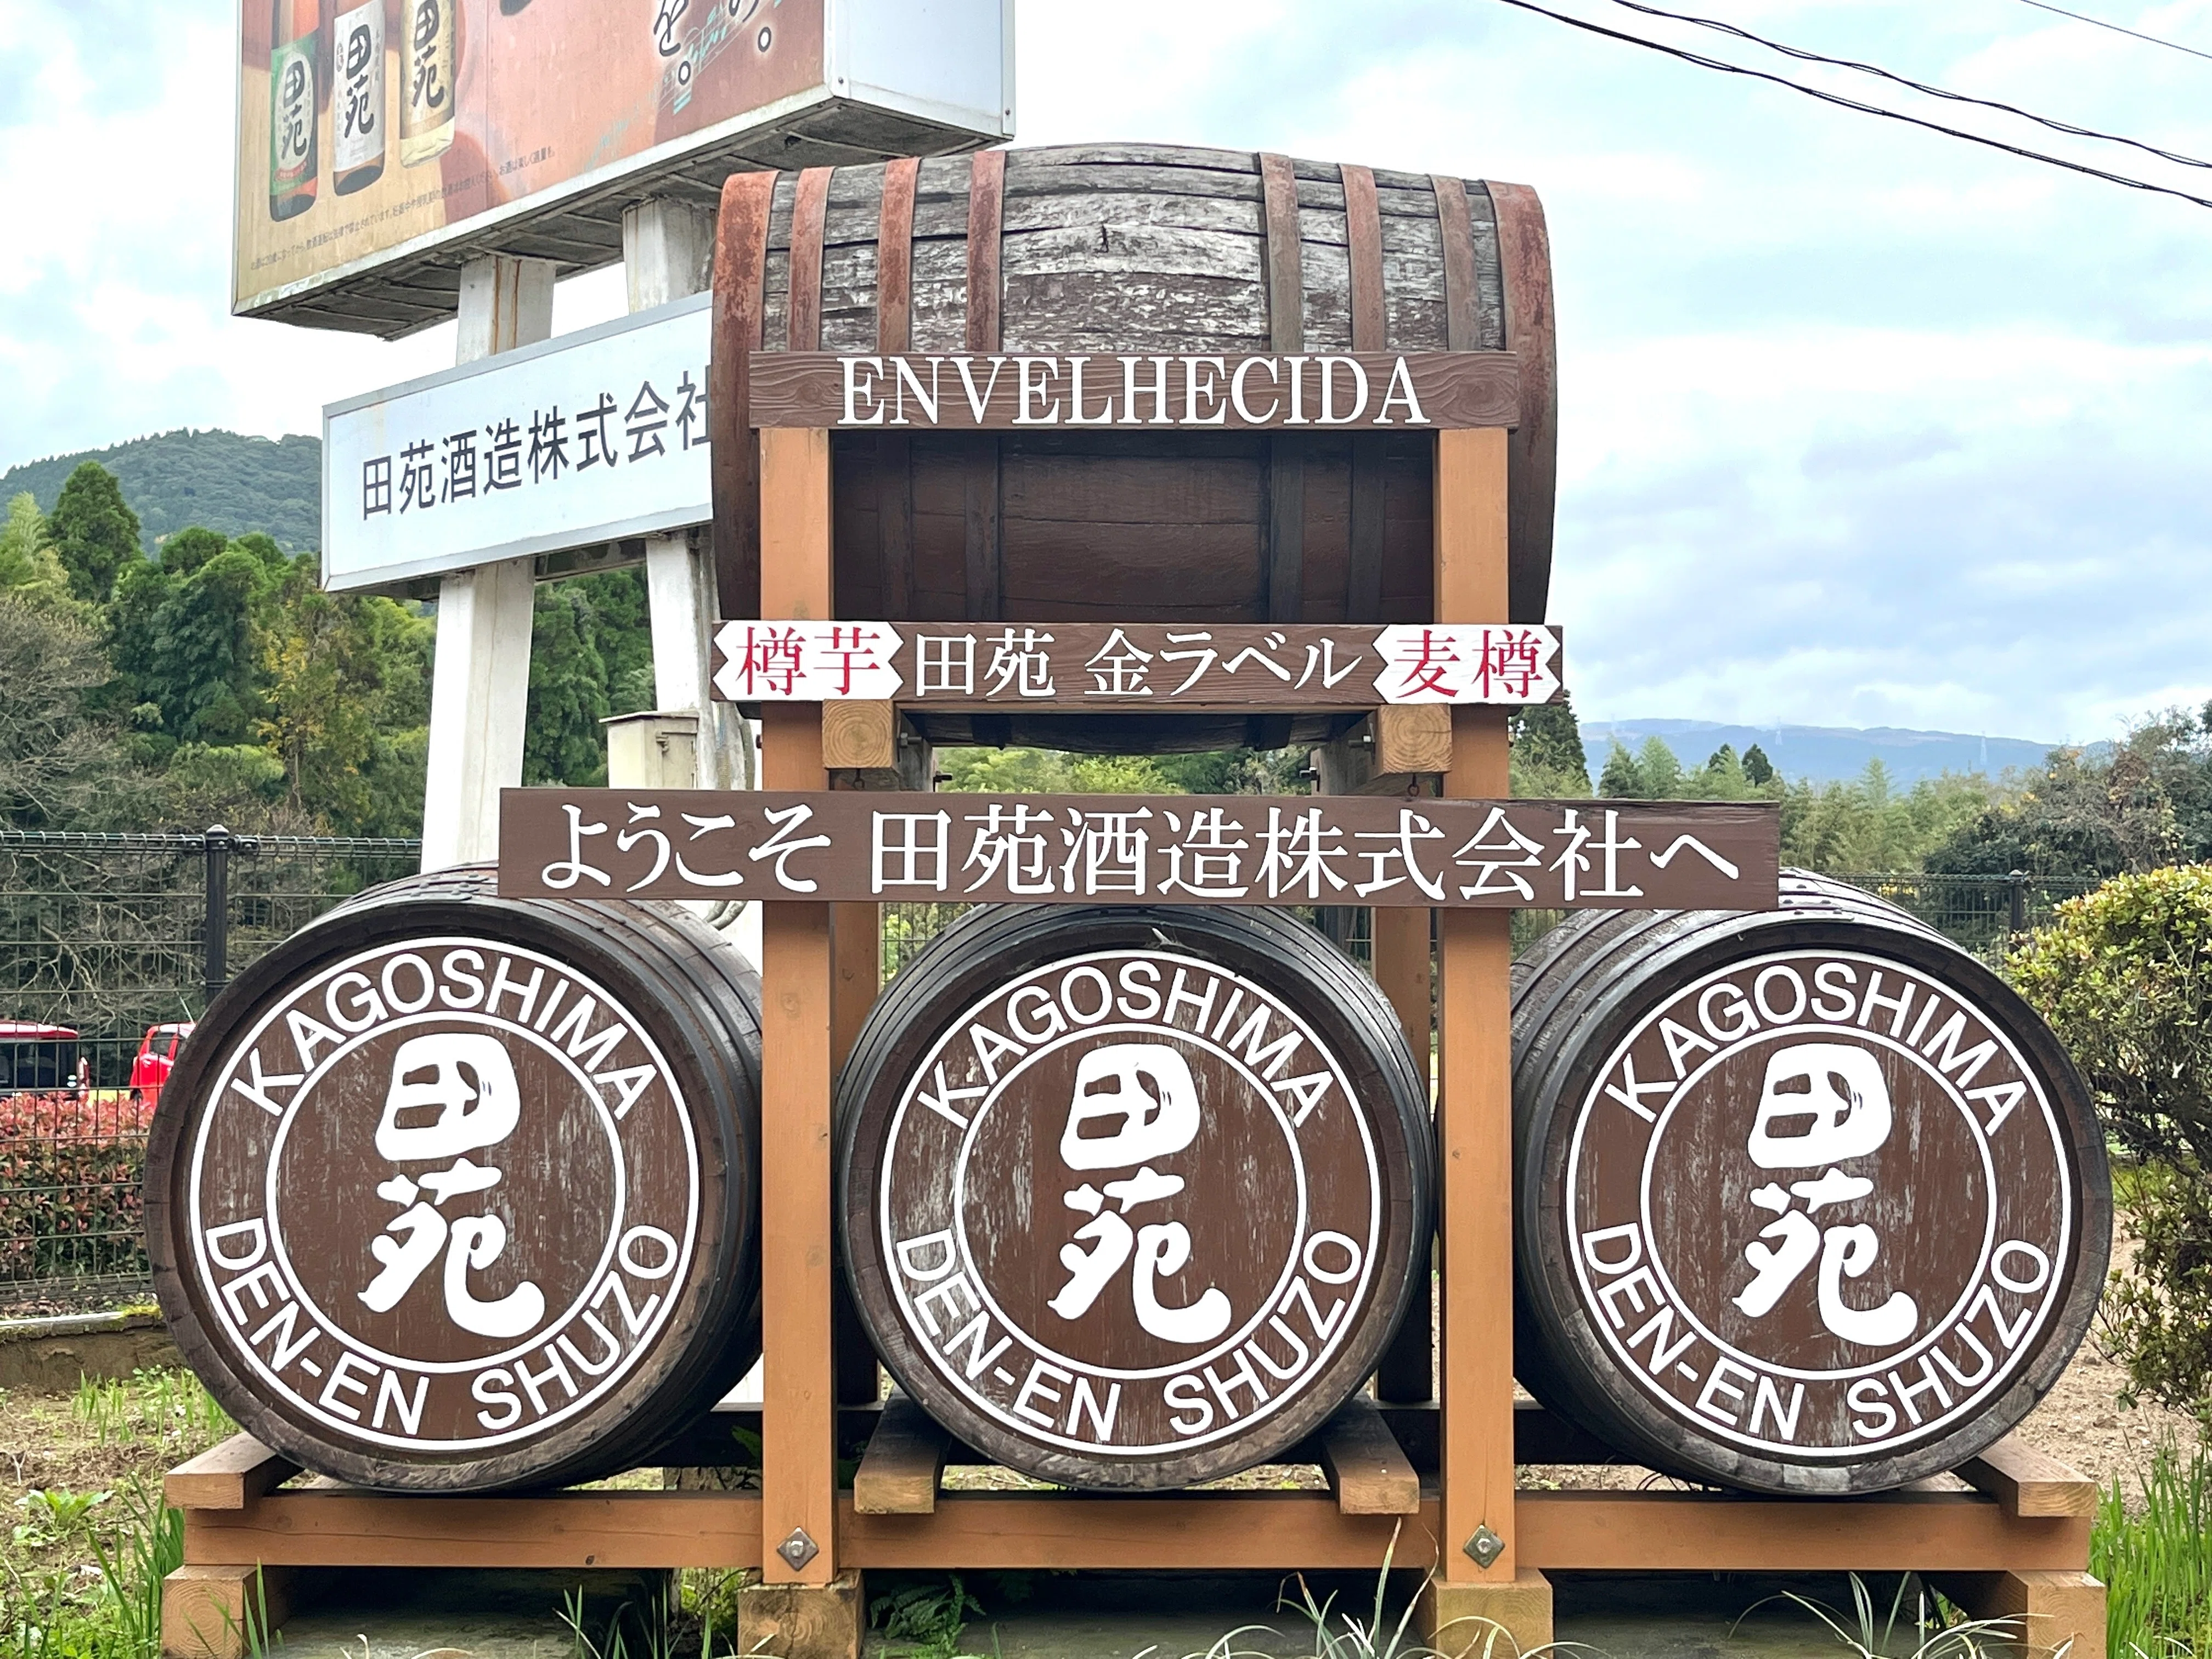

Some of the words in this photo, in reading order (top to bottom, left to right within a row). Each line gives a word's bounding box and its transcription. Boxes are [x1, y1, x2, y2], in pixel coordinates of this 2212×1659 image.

[281, 60, 307, 160] 田苑
[344, 24, 374, 138] 田苑
[411, 0, 444, 108] 田苑
[362, 364, 712, 520] 田苑酒造株式会社
[837, 356, 1431, 426] ENVELHECIDA
[735, 626, 881, 697] 樽芋
[915, 626, 1057, 698] 田苑
[1084, 627, 1363, 698] 金ラベル
[1394, 627, 1545, 701] 麦樽
[540, 801, 832, 893] ようこそ
[871, 804, 1740, 902] 田苑酒造株式会社へ
[232, 949, 657, 1119] KAGOSHIMA
[917, 960, 1333, 1128] KAGOSHIMA
[1604, 962, 2028, 1136] KAGOSHIMA
[357, 1032, 545, 1337] 田苑
[1047, 1043, 1231, 1342] 田苑
[1731, 1042, 1918, 1346] 田苑
[206, 1217, 430, 1435] DEN-EN
[471, 1225, 678, 1430] SHUZO
[896, 1228, 1121, 1441] DEN-EN
[1163, 1231, 1362, 1435] SHUZO
[1582, 1222, 1804, 1441] DEN-EN
[1846, 1239, 2050, 1438] SHUZO
